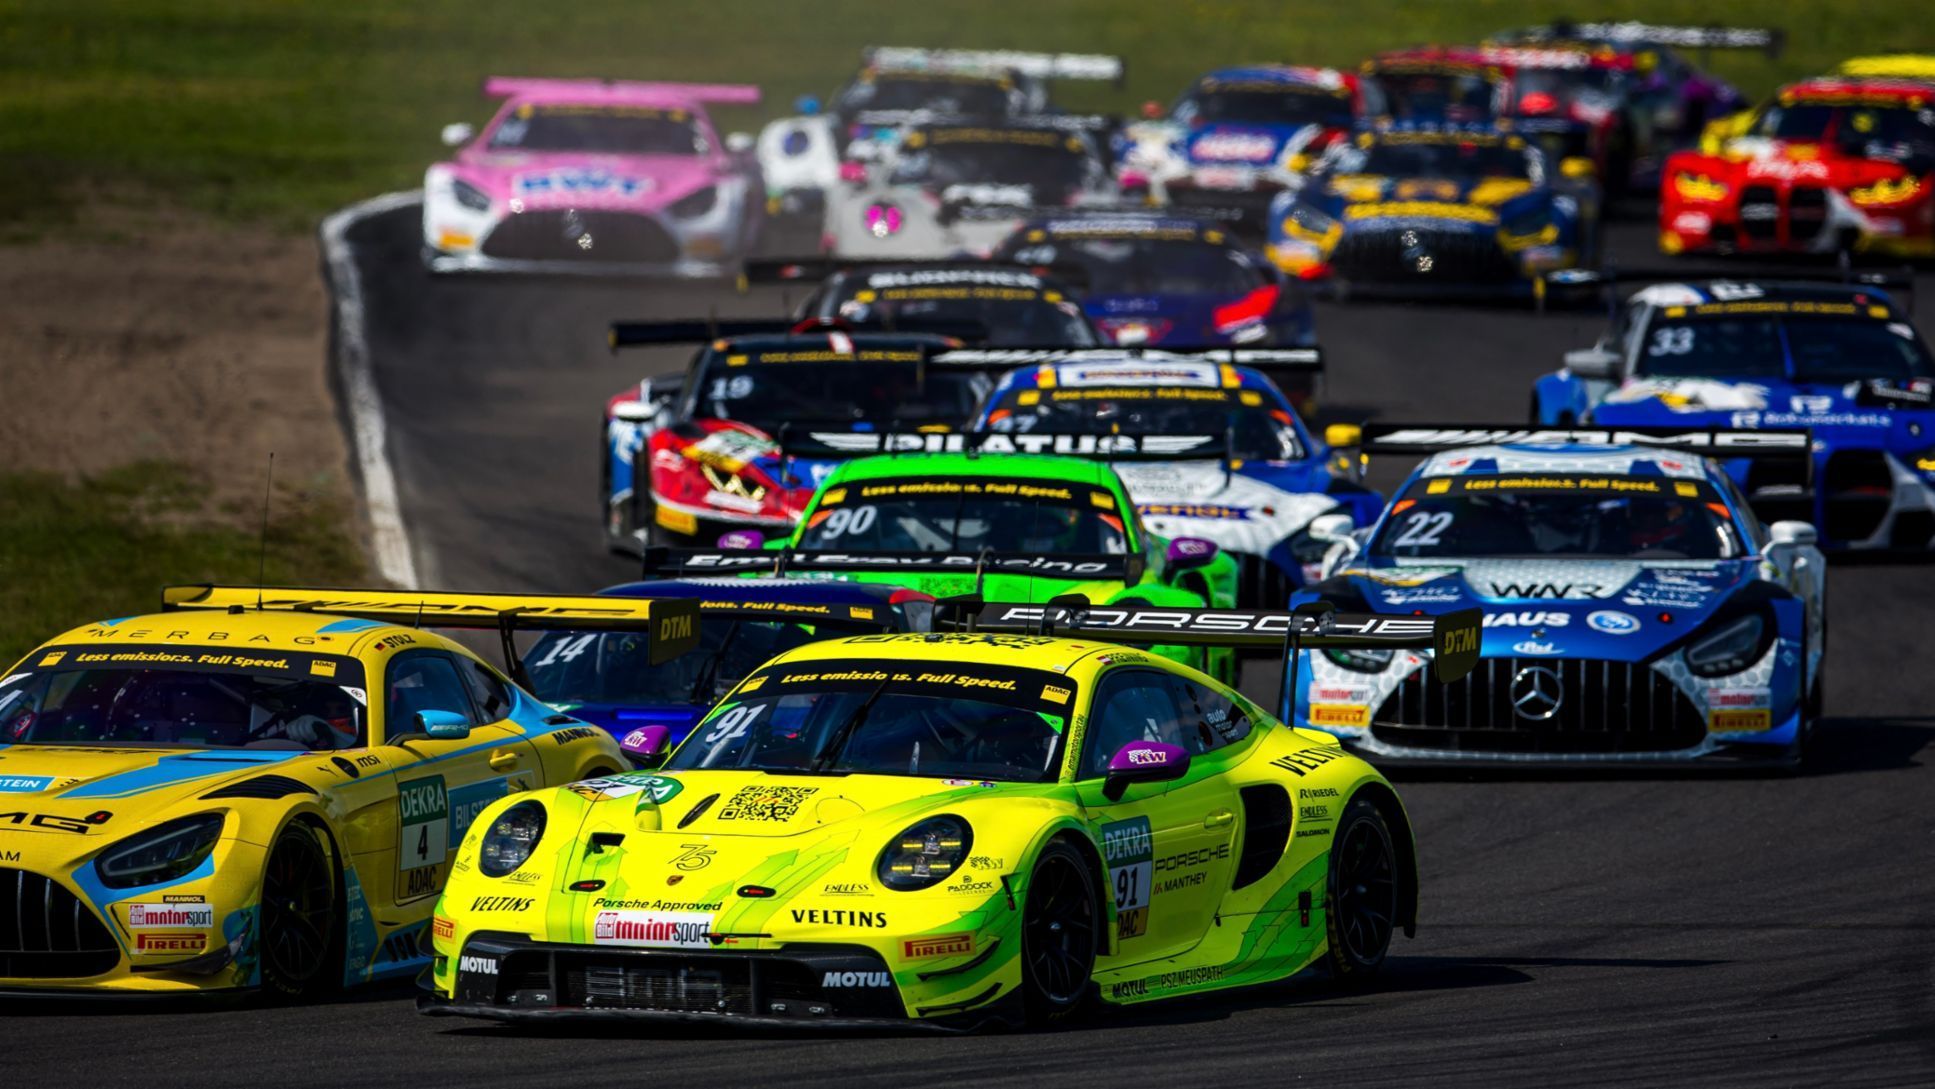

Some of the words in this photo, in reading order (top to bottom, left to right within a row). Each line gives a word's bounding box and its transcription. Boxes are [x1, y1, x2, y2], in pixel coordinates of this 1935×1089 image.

[1649, 327, 1695, 355] 33
[707, 376, 754, 399] 19
[884, 434, 1137, 453] PILATUS
[821, 505, 877, 540] 90
[1394, 511, 1454, 546] 22
[743, 602, 774, 611] Full
[776, 603, 830, 615] Speed.
[660, 614, 692, 641] DTM
[1001, 608, 1435, 634] PORSCHE
[96, 629, 316, 645] MERBAG
[382, 634, 416, 648] STOLZ
[1444, 625, 1477, 655] DTM
[535, 634, 597, 666] 14
[77, 653, 109, 663] Less
[197, 654, 231, 665] Full
[232, 656, 289, 669] Speed.
[313, 660, 336, 668] ADAC
[781, 673, 817, 684] Less
[916, 673, 954, 684] Full
[953, 676, 1017, 691] Speed.
[1046, 687, 1068, 695] ADAC
[705, 703, 767, 742] 91
[1206, 709, 1226, 723] auto
[356, 755, 381, 768] msi
[1137, 751, 1167, 765] KW
[402, 784, 446, 818] DEKRA
[418, 825, 427, 860] 4
[1104, 824, 1150, 861] DEKRA
[668, 844, 717, 871] 75
[1155, 844, 1229, 873] PORSCHE
[408, 866, 436, 894] ADAC
[947, 881, 993, 892] PADDOCK
[1117, 867, 1139, 909] 91
[1165, 872, 1207, 891] MANTHEY
[470, 896, 535, 912] VELTINS
[593, 898, 649, 909] Porsche
[651, 900, 723, 911] Approved
[791, 909, 887, 928] VELTINS
[137, 934, 207, 949] PIRELLI
[904, 935, 970, 957] PIRELLI
[460, 956, 498, 974] MOTUL
[822, 972, 890, 987] MOTUL
[1113, 979, 1149, 998] MOTUL
